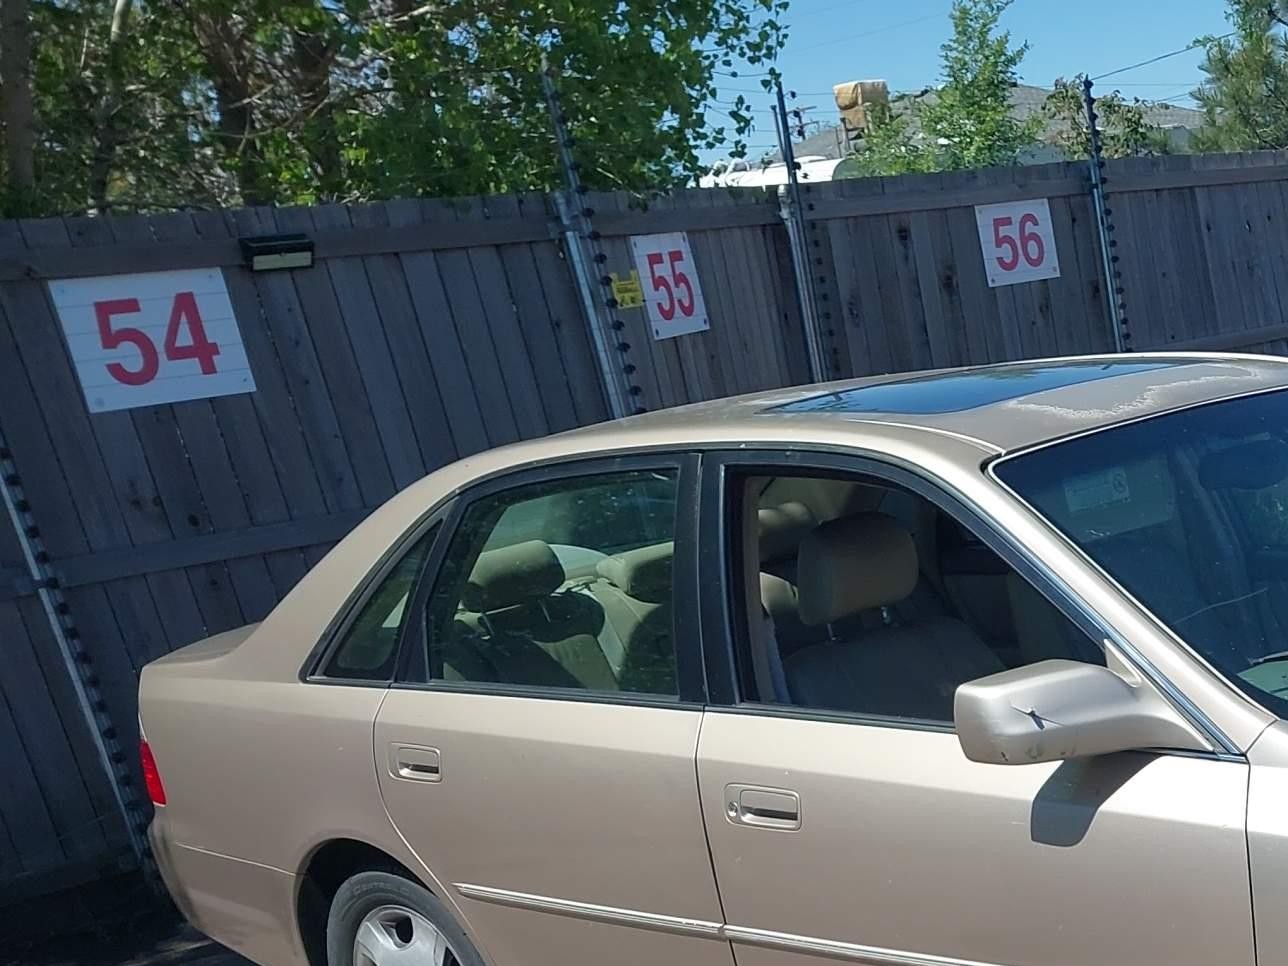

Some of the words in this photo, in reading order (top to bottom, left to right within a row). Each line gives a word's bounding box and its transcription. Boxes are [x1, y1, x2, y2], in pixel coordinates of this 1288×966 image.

[993, 213, 1045, 271] 56
[647, 250, 695, 320] 55
[94, 291, 221, 386] 54
